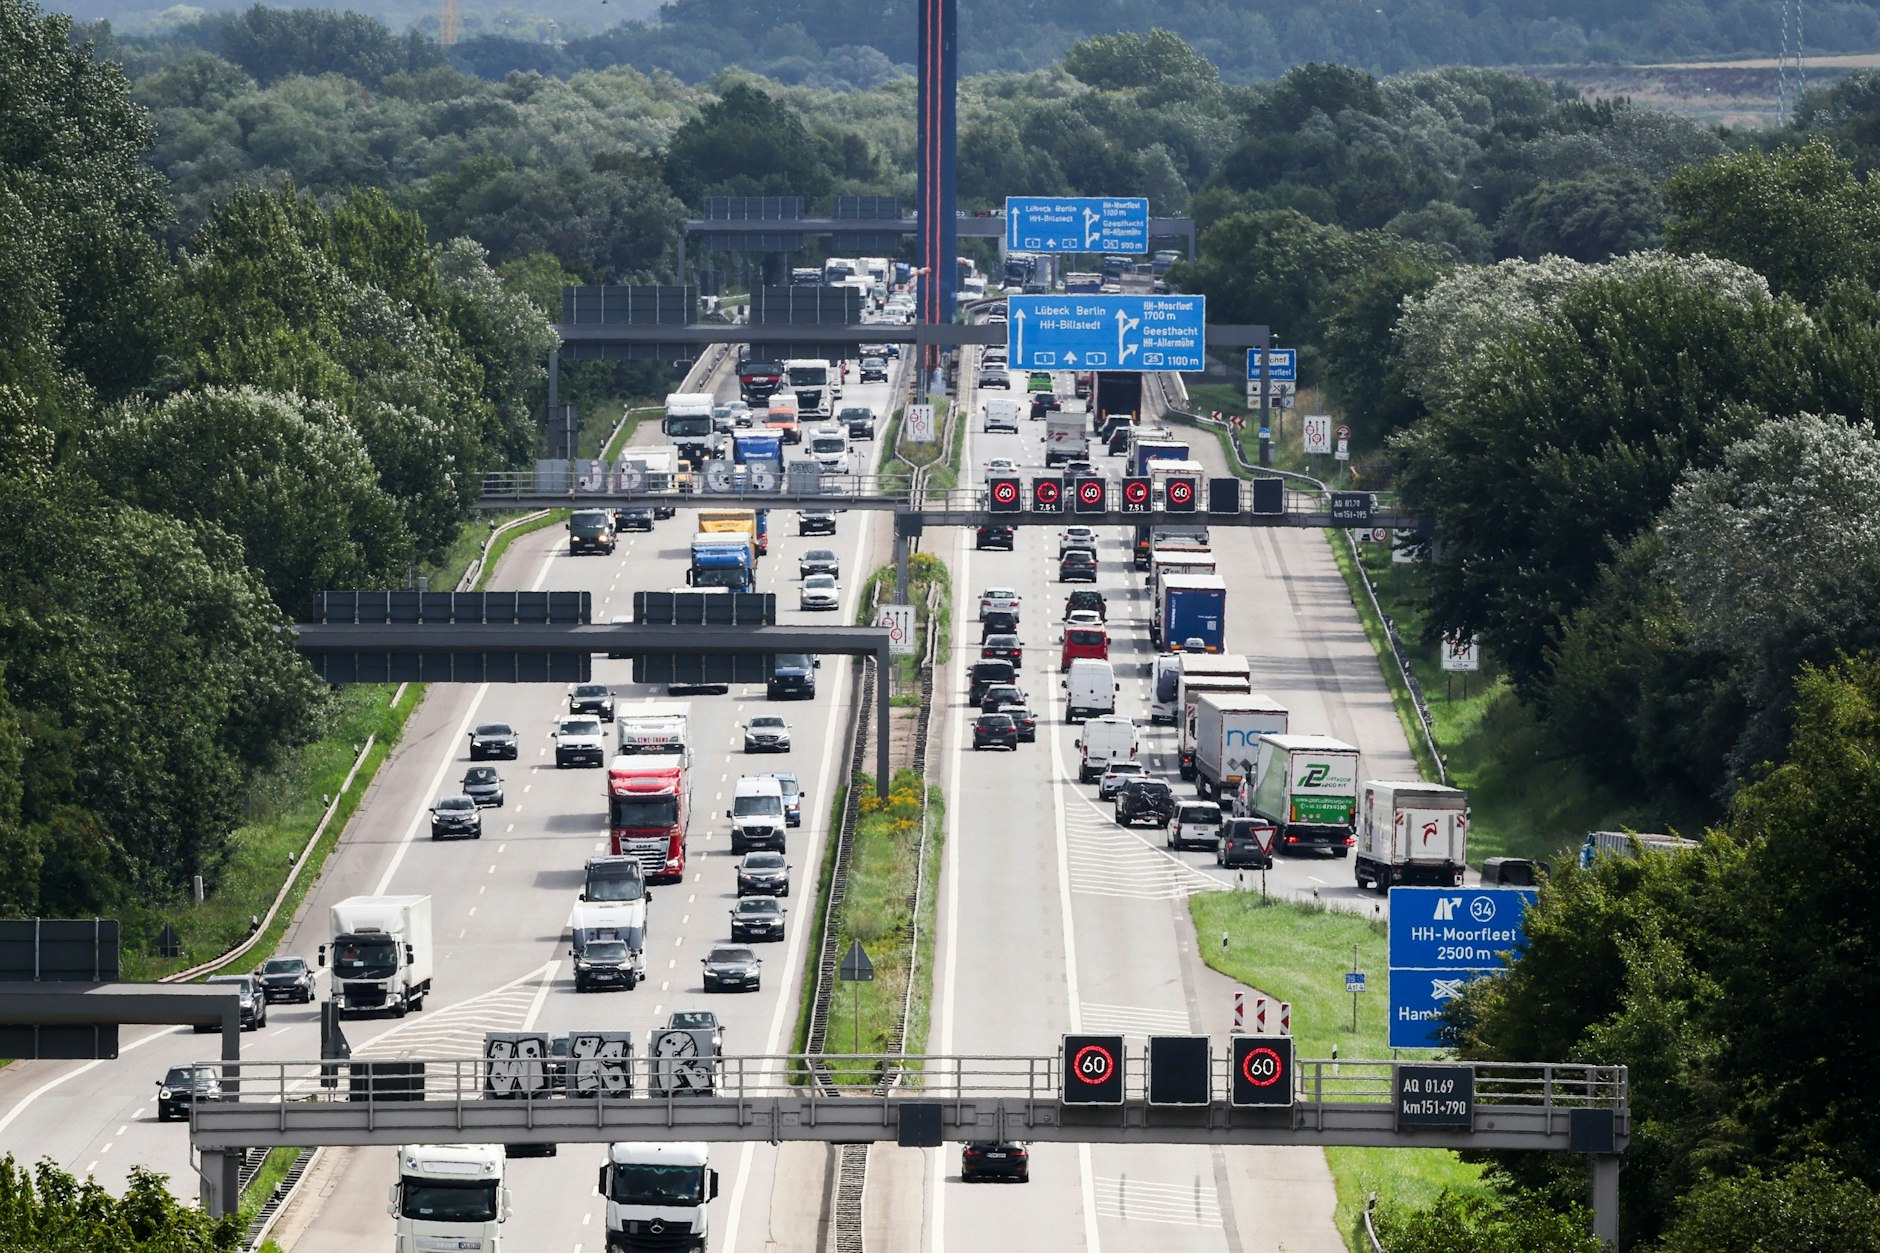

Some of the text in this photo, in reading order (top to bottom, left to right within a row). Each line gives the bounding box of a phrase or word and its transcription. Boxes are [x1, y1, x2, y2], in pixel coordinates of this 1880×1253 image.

[1055, 205, 1077, 213] Berlin
[1035, 306, 1106, 316] Lübeck Berlin
[1143, 301, 1194, 311] HH-Moorfleet
[1144, 311, 1176, 321] 1700 m
[1040, 320, 1101, 330] HH-Billstedt
[1143, 327, 1199, 336] Geesthacht
[1143, 338, 1195, 348] HH-Allermöhe
[1148, 355, 1159, 363] 25
[1167, 356, 1188, 366] 1100
[999, 488, 1012, 498] 60
[1084, 488, 1098, 498] 60
[1174, 488, 1188, 498] 60
[1473, 902, 1493, 916] 34
[1411, 926, 1516, 942] HH-Moorfleet
[1437, 946, 1491, 960] 2500 m
[1082, 1056, 1106, 1074] 60
[1251, 1058, 1274, 1076] 60
[1403, 1079, 1420, 1093] AQ
